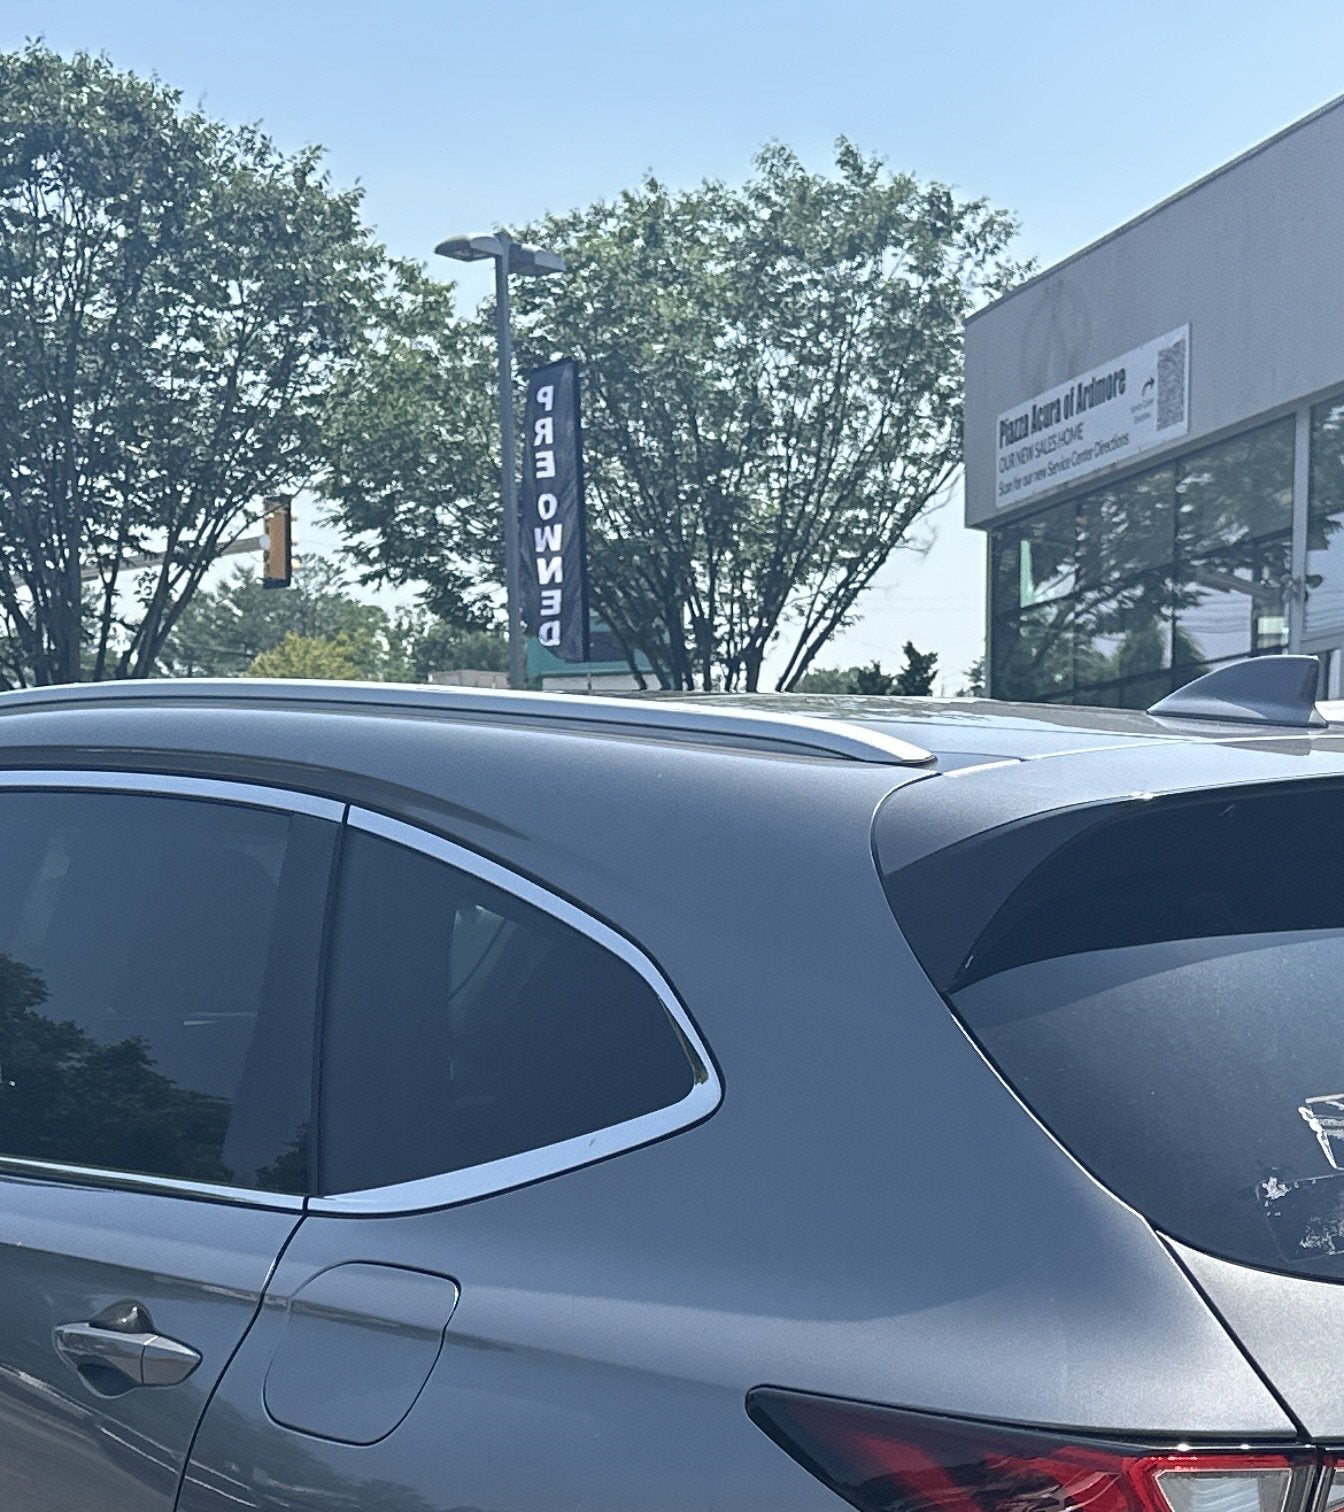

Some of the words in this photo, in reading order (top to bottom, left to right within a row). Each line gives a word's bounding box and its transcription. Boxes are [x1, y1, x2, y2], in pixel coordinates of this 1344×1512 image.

[999, 413, 1029, 450] Piazza
[1031, 398, 1061, 435] Acura
[1063, 386, 1075, 420] of
[1075, 368, 1126, 415] Ardmore
[998, 452, 1015, 474] OUR
[1016, 445, 1035, 465] NEW
[1034, 433, 1058, 459] SALES
[1057, 422, 1084, 446] HOME
